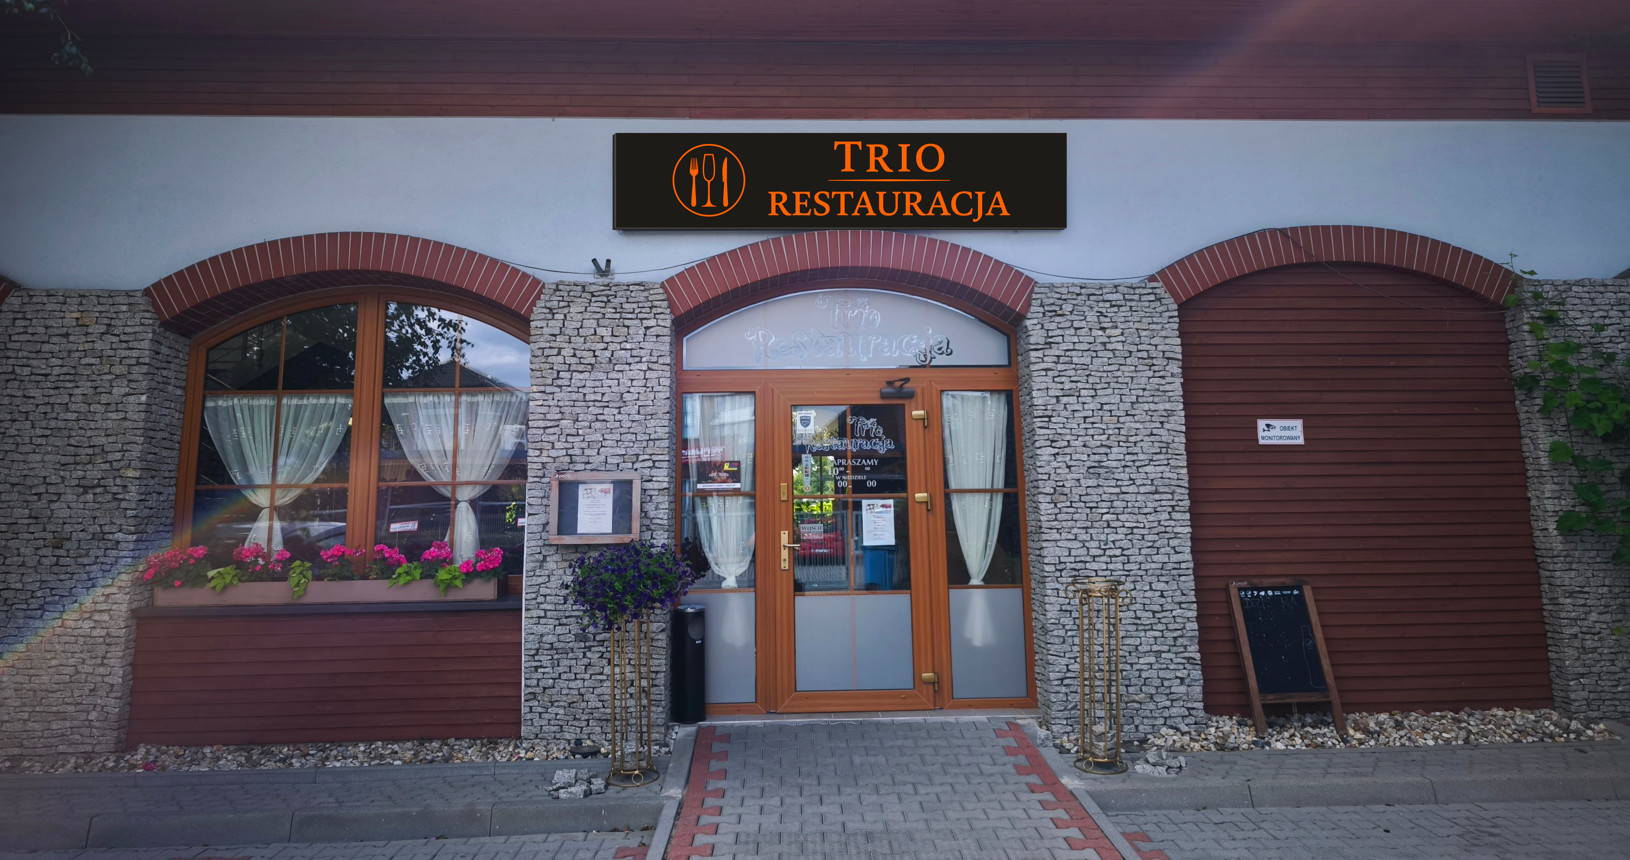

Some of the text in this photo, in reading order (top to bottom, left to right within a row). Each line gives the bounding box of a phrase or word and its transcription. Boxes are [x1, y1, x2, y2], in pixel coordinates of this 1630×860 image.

[833, 140, 946, 173] TRIO
[767, 190, 1011, 222] RESTAURACJA
[829, 458, 879, 466] APRASZAMY
